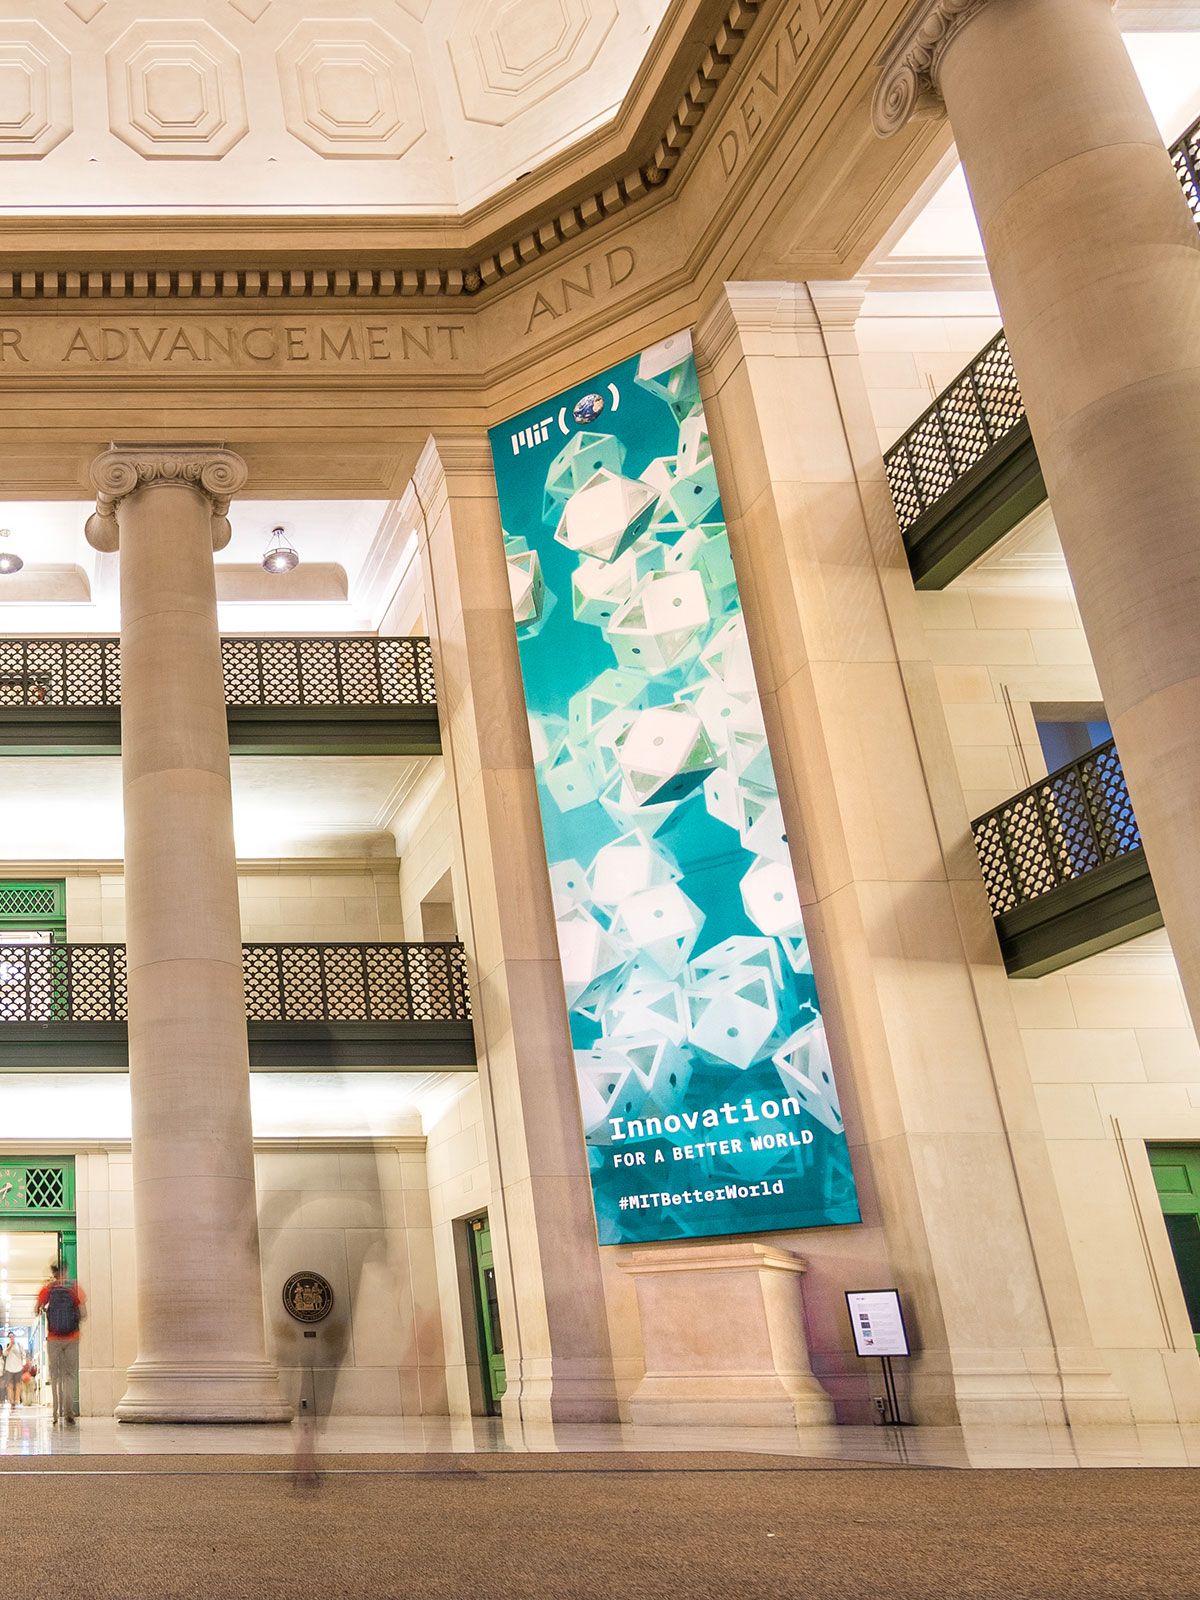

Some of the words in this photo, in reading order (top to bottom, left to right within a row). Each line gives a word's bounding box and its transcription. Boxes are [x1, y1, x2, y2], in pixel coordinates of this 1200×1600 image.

[523, 245, 637, 335] AND
[60, 326, 466, 363] ADVANCEMENT
[608, 1096, 801, 1141] Innovation
[613, 1152, 647, 1169] FOR
[654, 1149, 665, 1164] A
[672, 1139, 743, 1161] BETTER
[750, 1129, 814, 1151] WORLD
[618, 1179, 784, 1211] #MITBetterWorld
